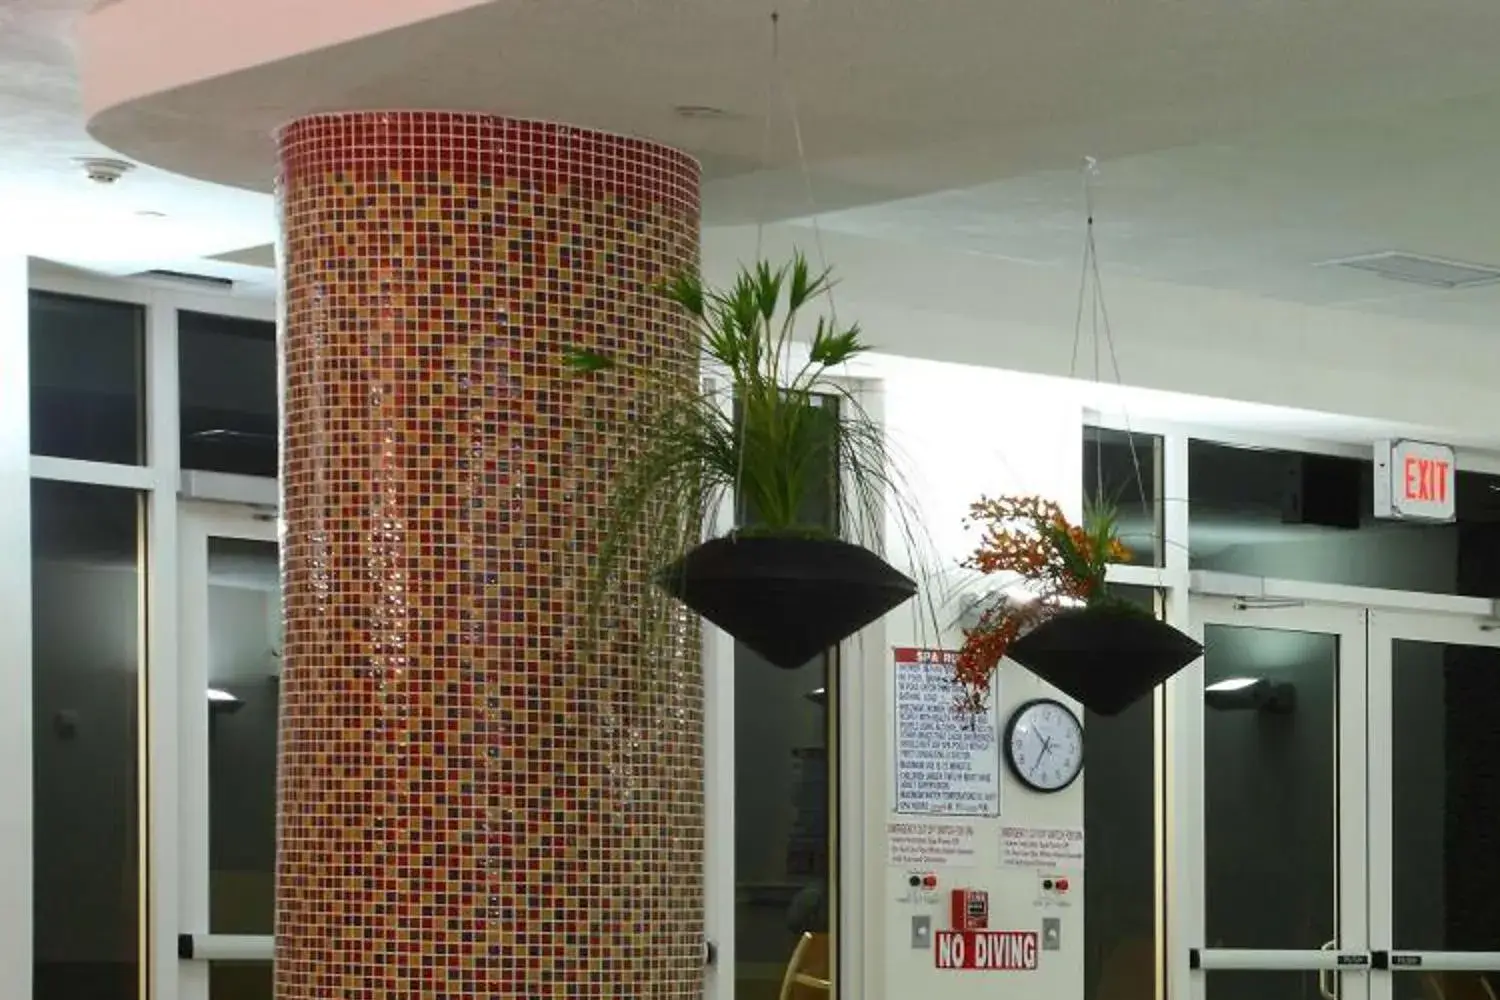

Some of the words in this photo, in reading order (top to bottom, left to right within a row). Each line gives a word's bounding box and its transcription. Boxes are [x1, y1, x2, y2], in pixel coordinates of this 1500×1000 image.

[1405, 459, 1448, 503] EXIT
[917, 651, 939, 663] SPA
[939, 933, 965, 967] NO
[975, 933, 1035, 968] DIVING
